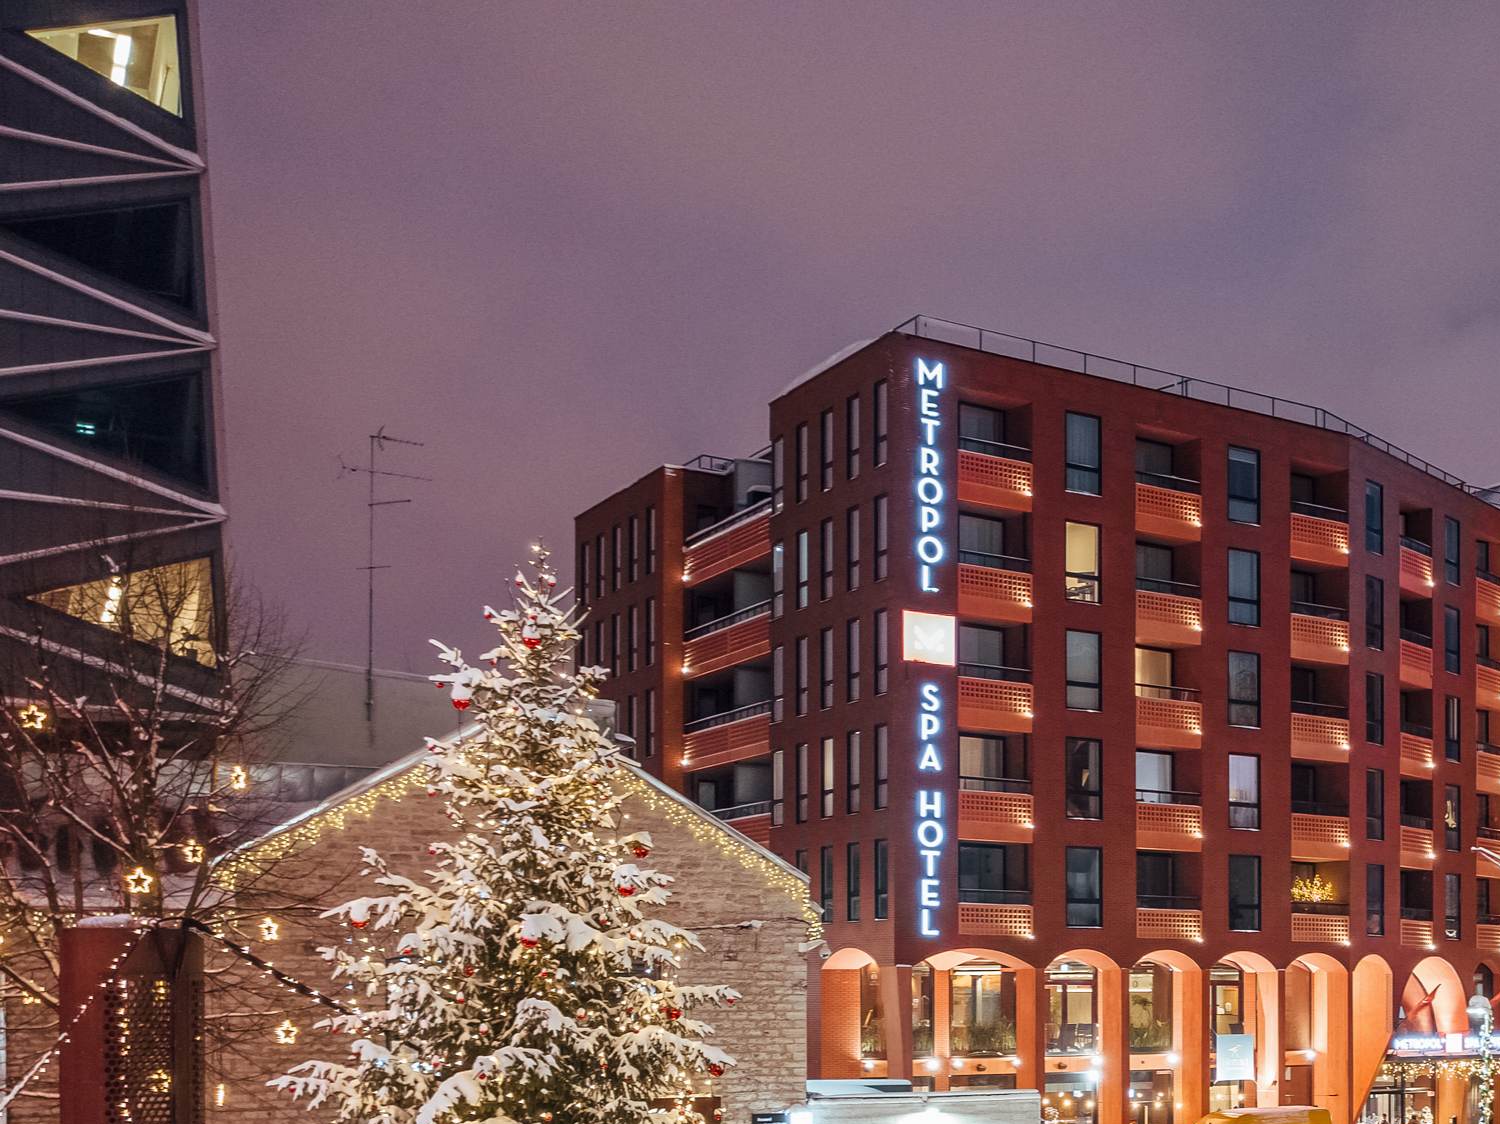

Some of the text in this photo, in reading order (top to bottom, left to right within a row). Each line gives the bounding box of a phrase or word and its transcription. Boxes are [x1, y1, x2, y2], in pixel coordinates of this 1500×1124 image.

[917, 357, 944, 937] METROPOL SPA HOTEL
